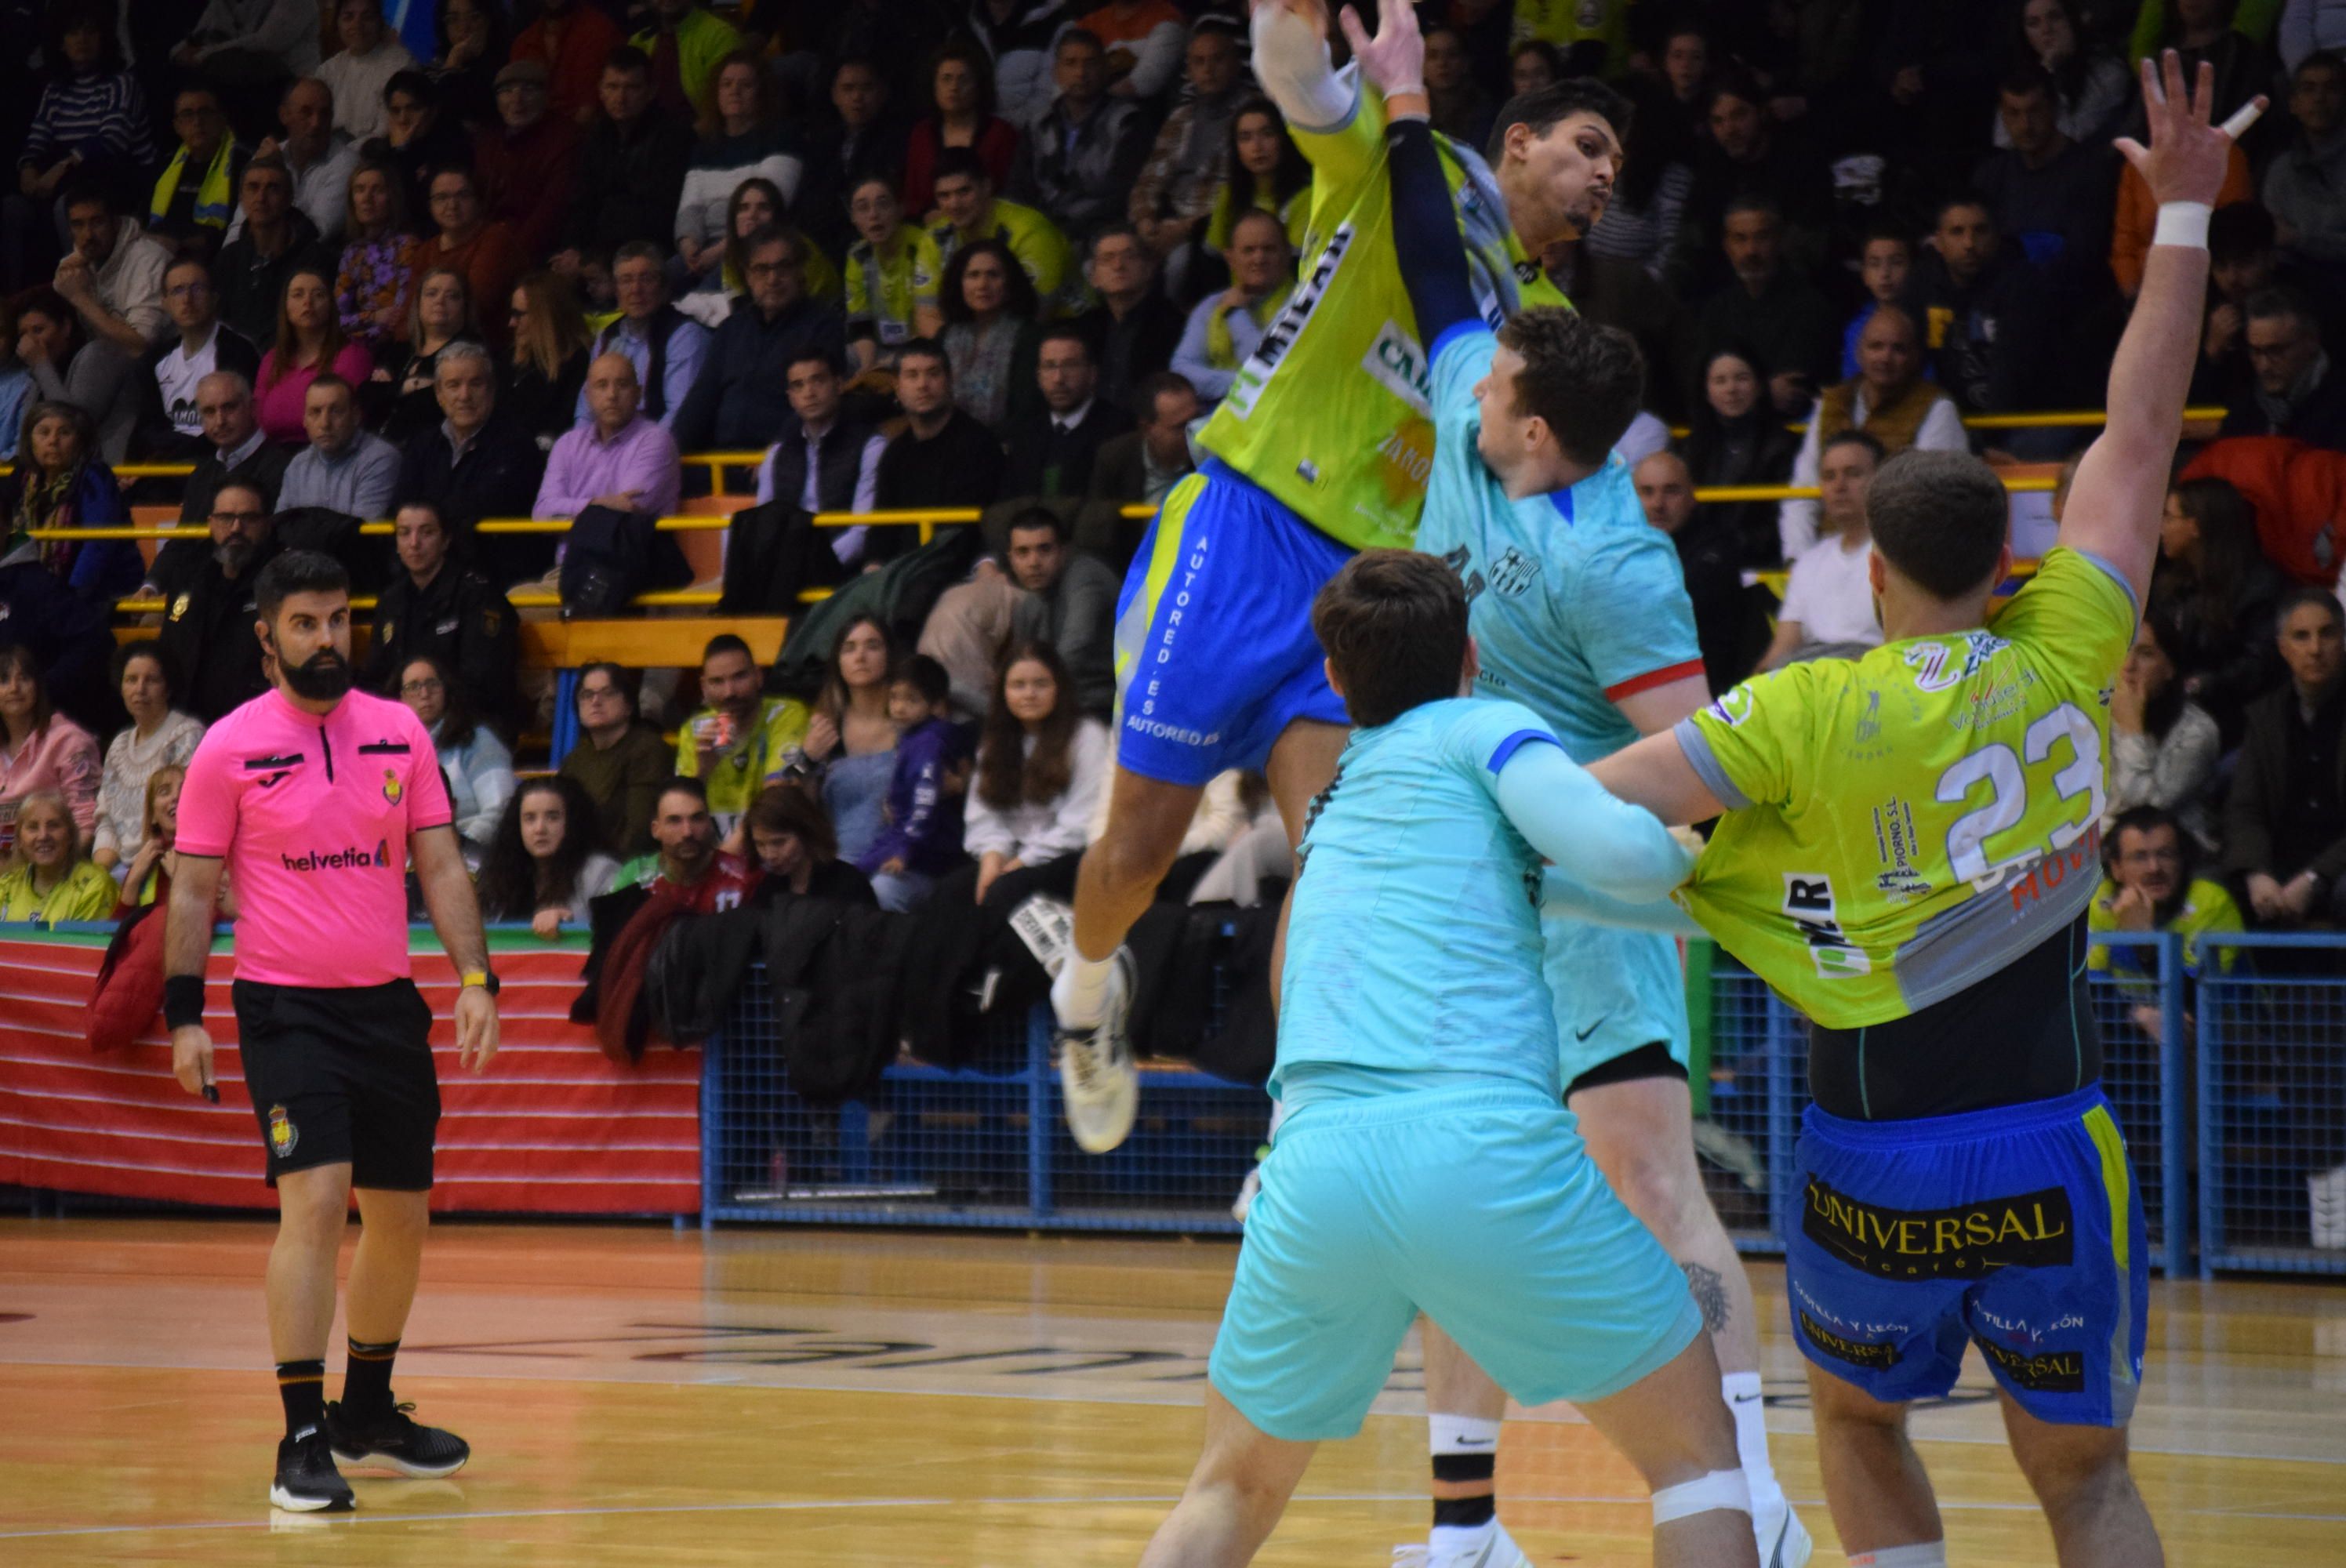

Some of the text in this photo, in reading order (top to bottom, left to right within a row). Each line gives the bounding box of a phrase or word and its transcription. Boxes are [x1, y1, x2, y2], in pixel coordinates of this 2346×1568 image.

[1935, 701, 2107, 884] 23
[281, 847, 371, 872] helvetia
[1809, 1184, 2065, 1255] UNIVERSAL
